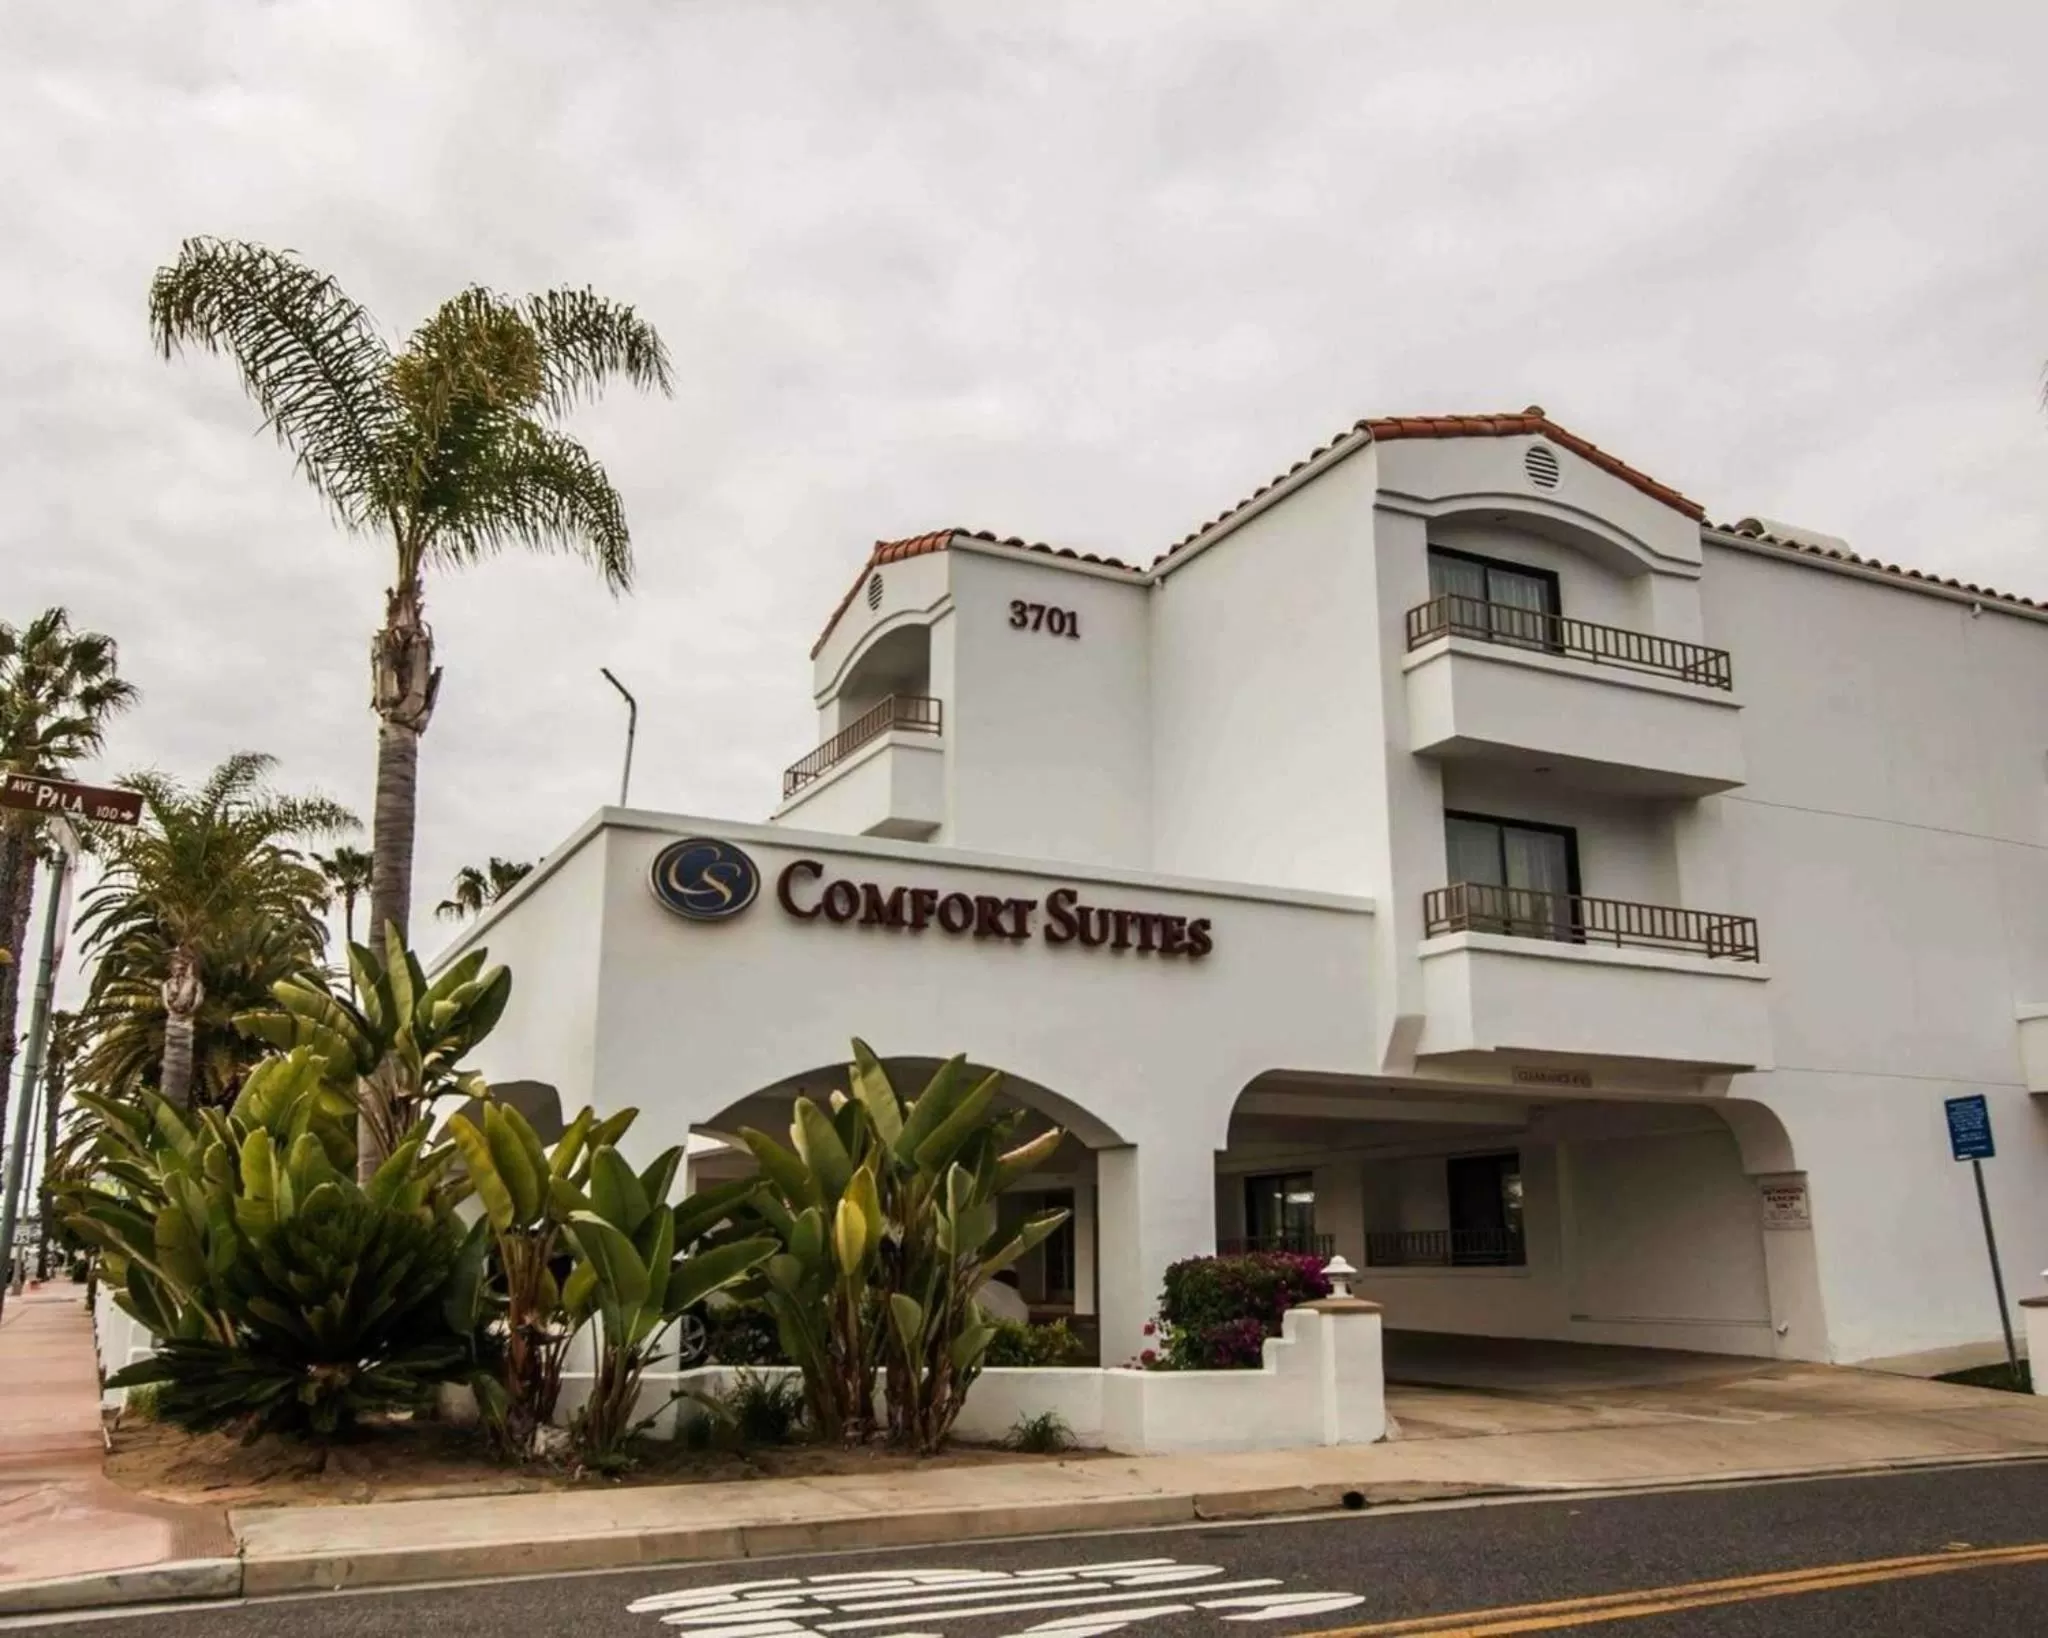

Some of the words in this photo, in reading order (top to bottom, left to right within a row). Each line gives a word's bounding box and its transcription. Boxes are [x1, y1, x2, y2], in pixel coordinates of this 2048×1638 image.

[1009, 599, 1081, 640] 3701
[11, 779, 36, 794] AVE
[35, 785, 83, 812] PALA
[96, 805, 119, 820] 100
[777, 858, 1037, 940] COMFORT
[1044, 888, 1213, 957] SUITES
